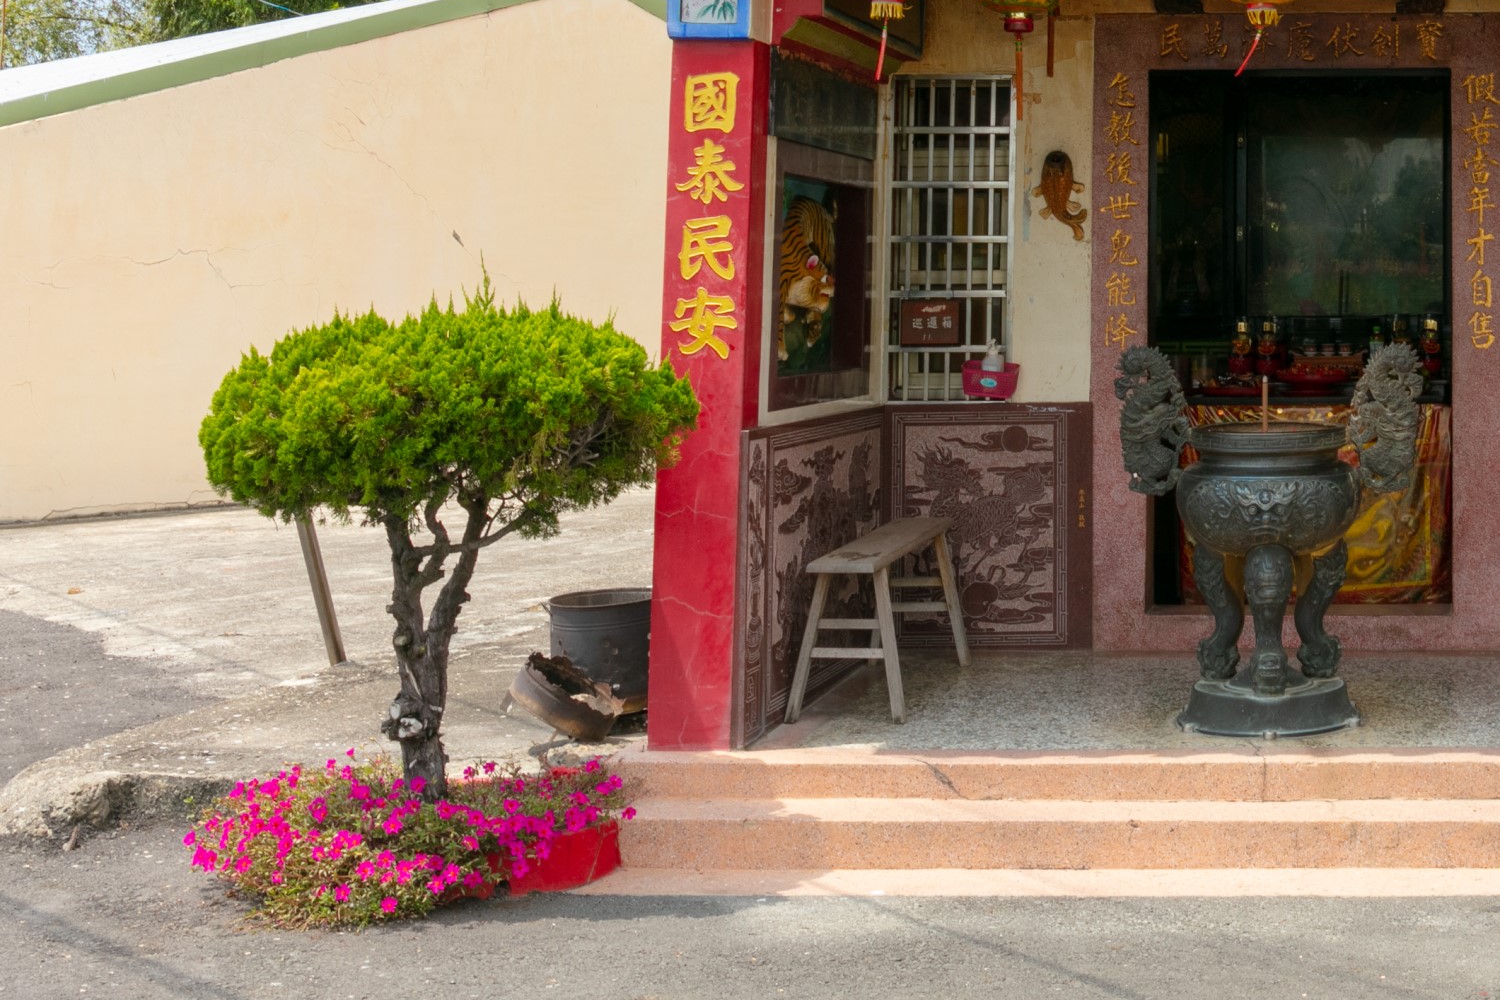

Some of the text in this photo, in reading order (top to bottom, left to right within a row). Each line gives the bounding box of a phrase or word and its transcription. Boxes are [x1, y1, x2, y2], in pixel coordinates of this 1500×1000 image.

[669, 71, 745, 360] 國泰民安
[1100, 71, 1139, 350] 怎教後世鬼能降
